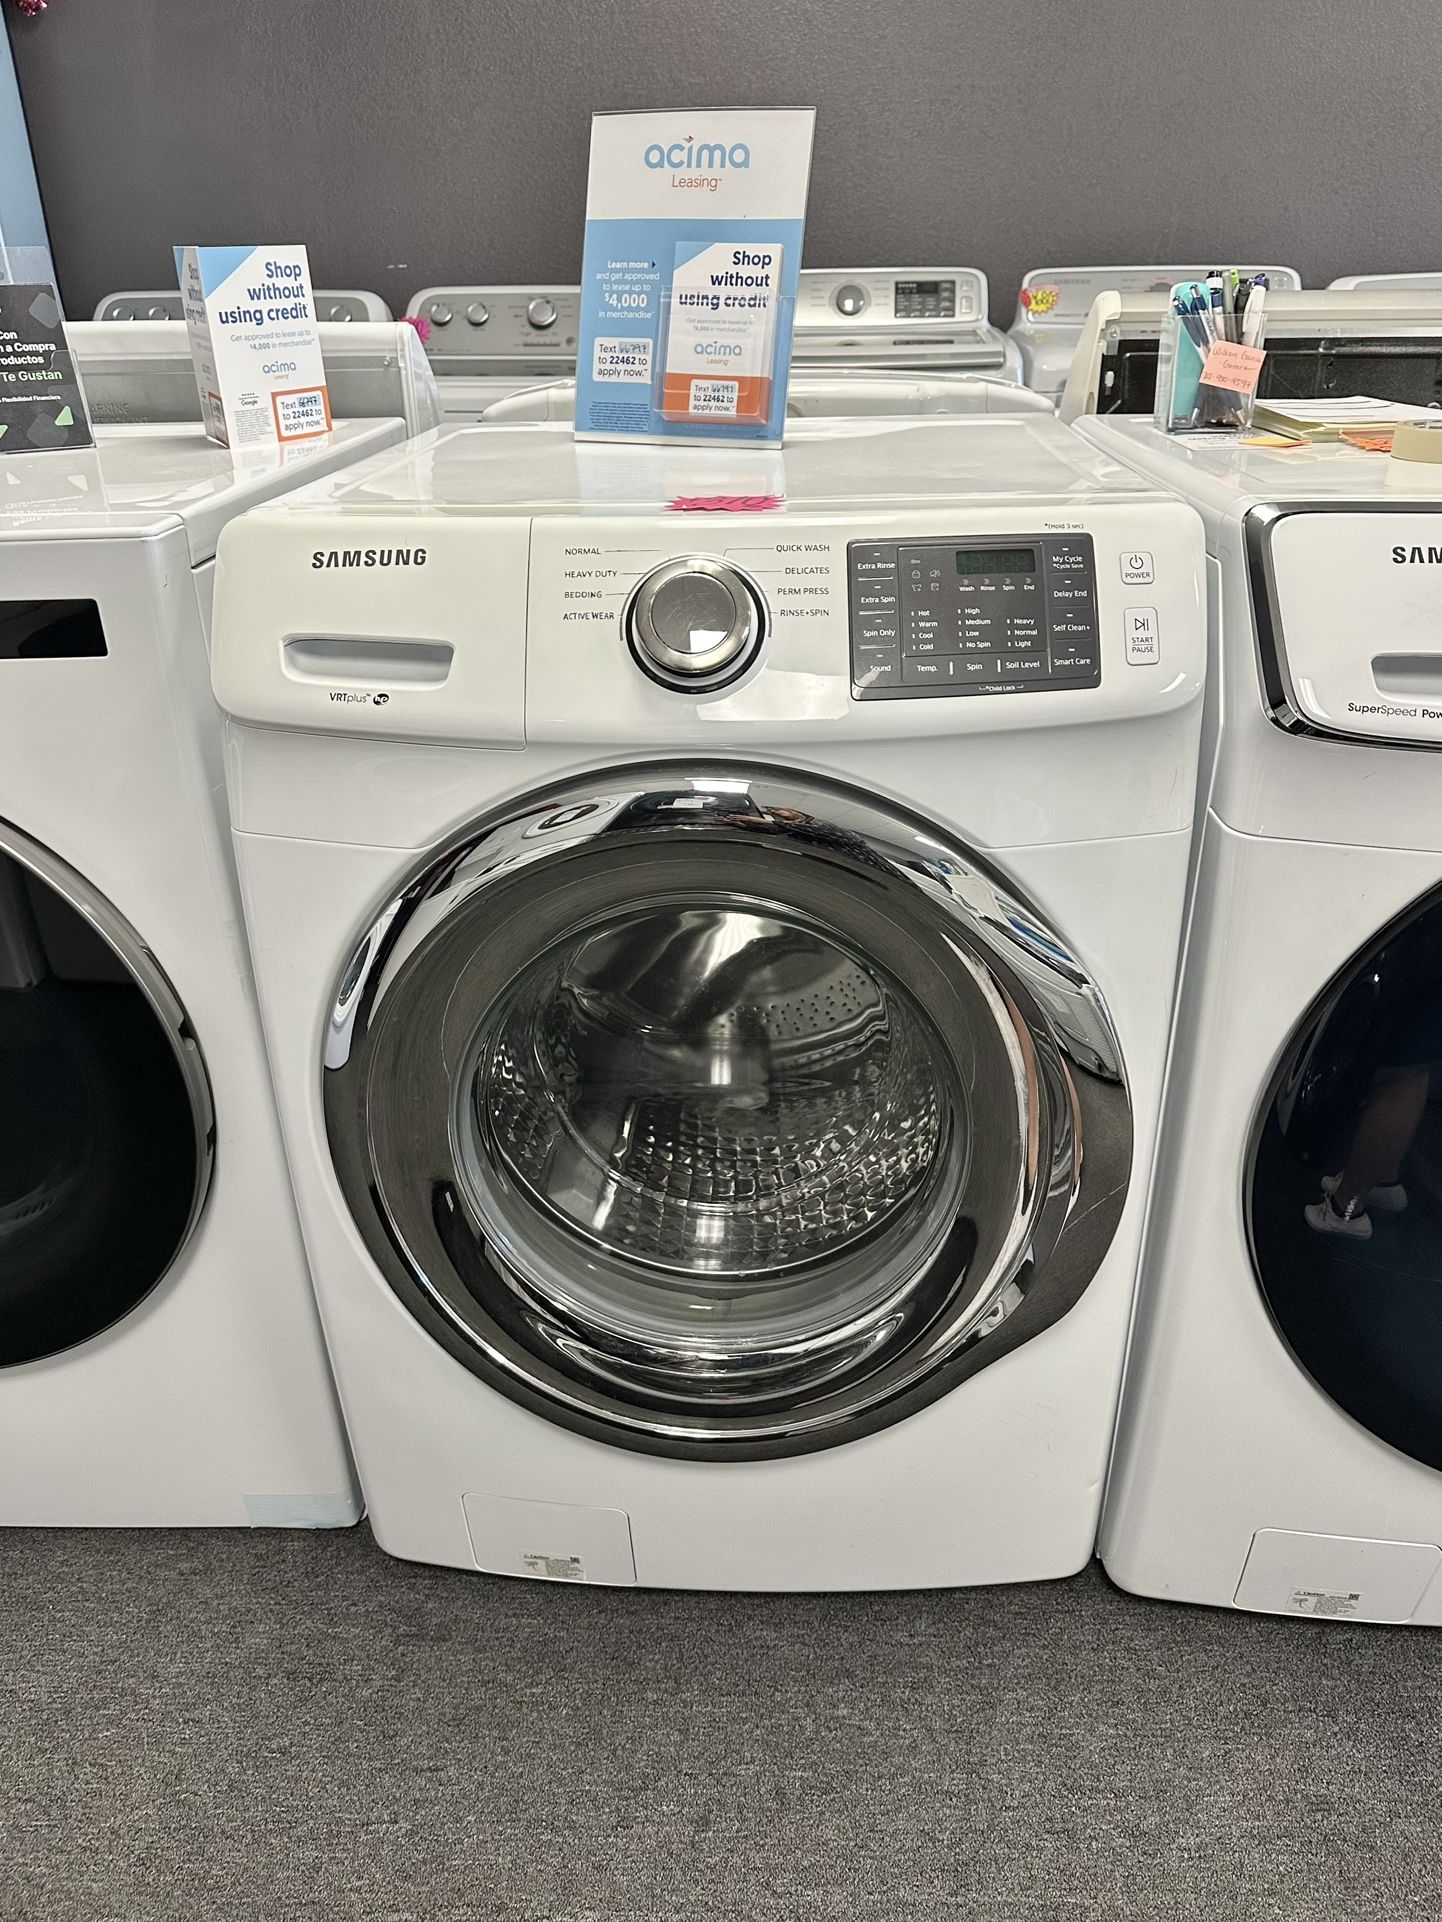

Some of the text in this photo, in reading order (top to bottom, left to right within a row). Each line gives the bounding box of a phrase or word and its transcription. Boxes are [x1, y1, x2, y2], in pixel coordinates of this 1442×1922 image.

[643, 136, 751, 170] acima
[732, 250, 772, 269] Shop
[607, 260, 649, 269] Learn more
[265, 261, 302, 281] Shop
[595, 271, 660, 281] and get approved
[710, 271, 770, 287] without
[602, 282, 651, 292] to lease up to
[247, 283, 305, 301] without
[604, 292, 648, 309] $4,000
[679, 291, 720, 311] using
[218, 305, 264, 326] using
[599, 310, 606, 318] in
[230, 334, 243, 342] Get
[243, 332, 274, 342] approved
[275, 331, 281, 339] to
[281, 330, 296, 338] lease
[13, 342, 57, 353] Compra
[598, 343, 617, 354] Text
[694, 341, 743, 356] acima
[598, 355, 648, 366] to 22462 to
[262, 360, 297, 374] acima
[2, 370, 63, 382] Te Gustan
[597, 367, 622, 378] apply
[694, 384, 710, 392] Text
[693, 394, 735, 403] to 22462 to
[90, 402, 130, 415] ARNING
[280, 401, 297, 410] Text
[692, 403, 713, 413] apply
[282, 408, 323, 421] to 22462 to
[284, 421, 305, 432] apply
[564, 547, 602, 556] NORMAL
[775, 544, 830, 553] QUICK WASH
[311, 548, 427, 569] SAMSUNG
[1052, 555, 1083, 563] My Cycle
[1391, 546, 1442, 564] SAM
[564, 570, 618, 578] HEAVY DUTY
[784, 566, 830, 575] DELICATES
[1124, 571, 1151, 579] POWER
[564, 590, 603, 599] BEDDING
[777, 587, 830, 595] PERM PRESS
[1053, 590, 1073, 599] Delay
[860, 595, 896, 604] Extra Spin
[562, 611, 615, 620] ACTIVE WEAR
[780, 608, 830, 617] RINSE+SPIN
[1013, 618, 1035, 626] Heavy
[1052, 624, 1066, 632] Self
[863, 628, 896, 638] Spin Only
[1014, 640, 1031, 648] Light
[1131, 636, 1154, 644] START
[976, 641, 991, 649] Spin
[1131, 645, 1154, 653] PAUSE
[1005, 660, 1040, 669] Soil Level
[1053, 657, 1091, 666] Smart Care
[870, 664, 892, 672] Sound
[917, 664, 938, 673] Temp.
[966, 662, 983, 671] Spin
[1348, 702, 1417, 717] SuperSpeed
